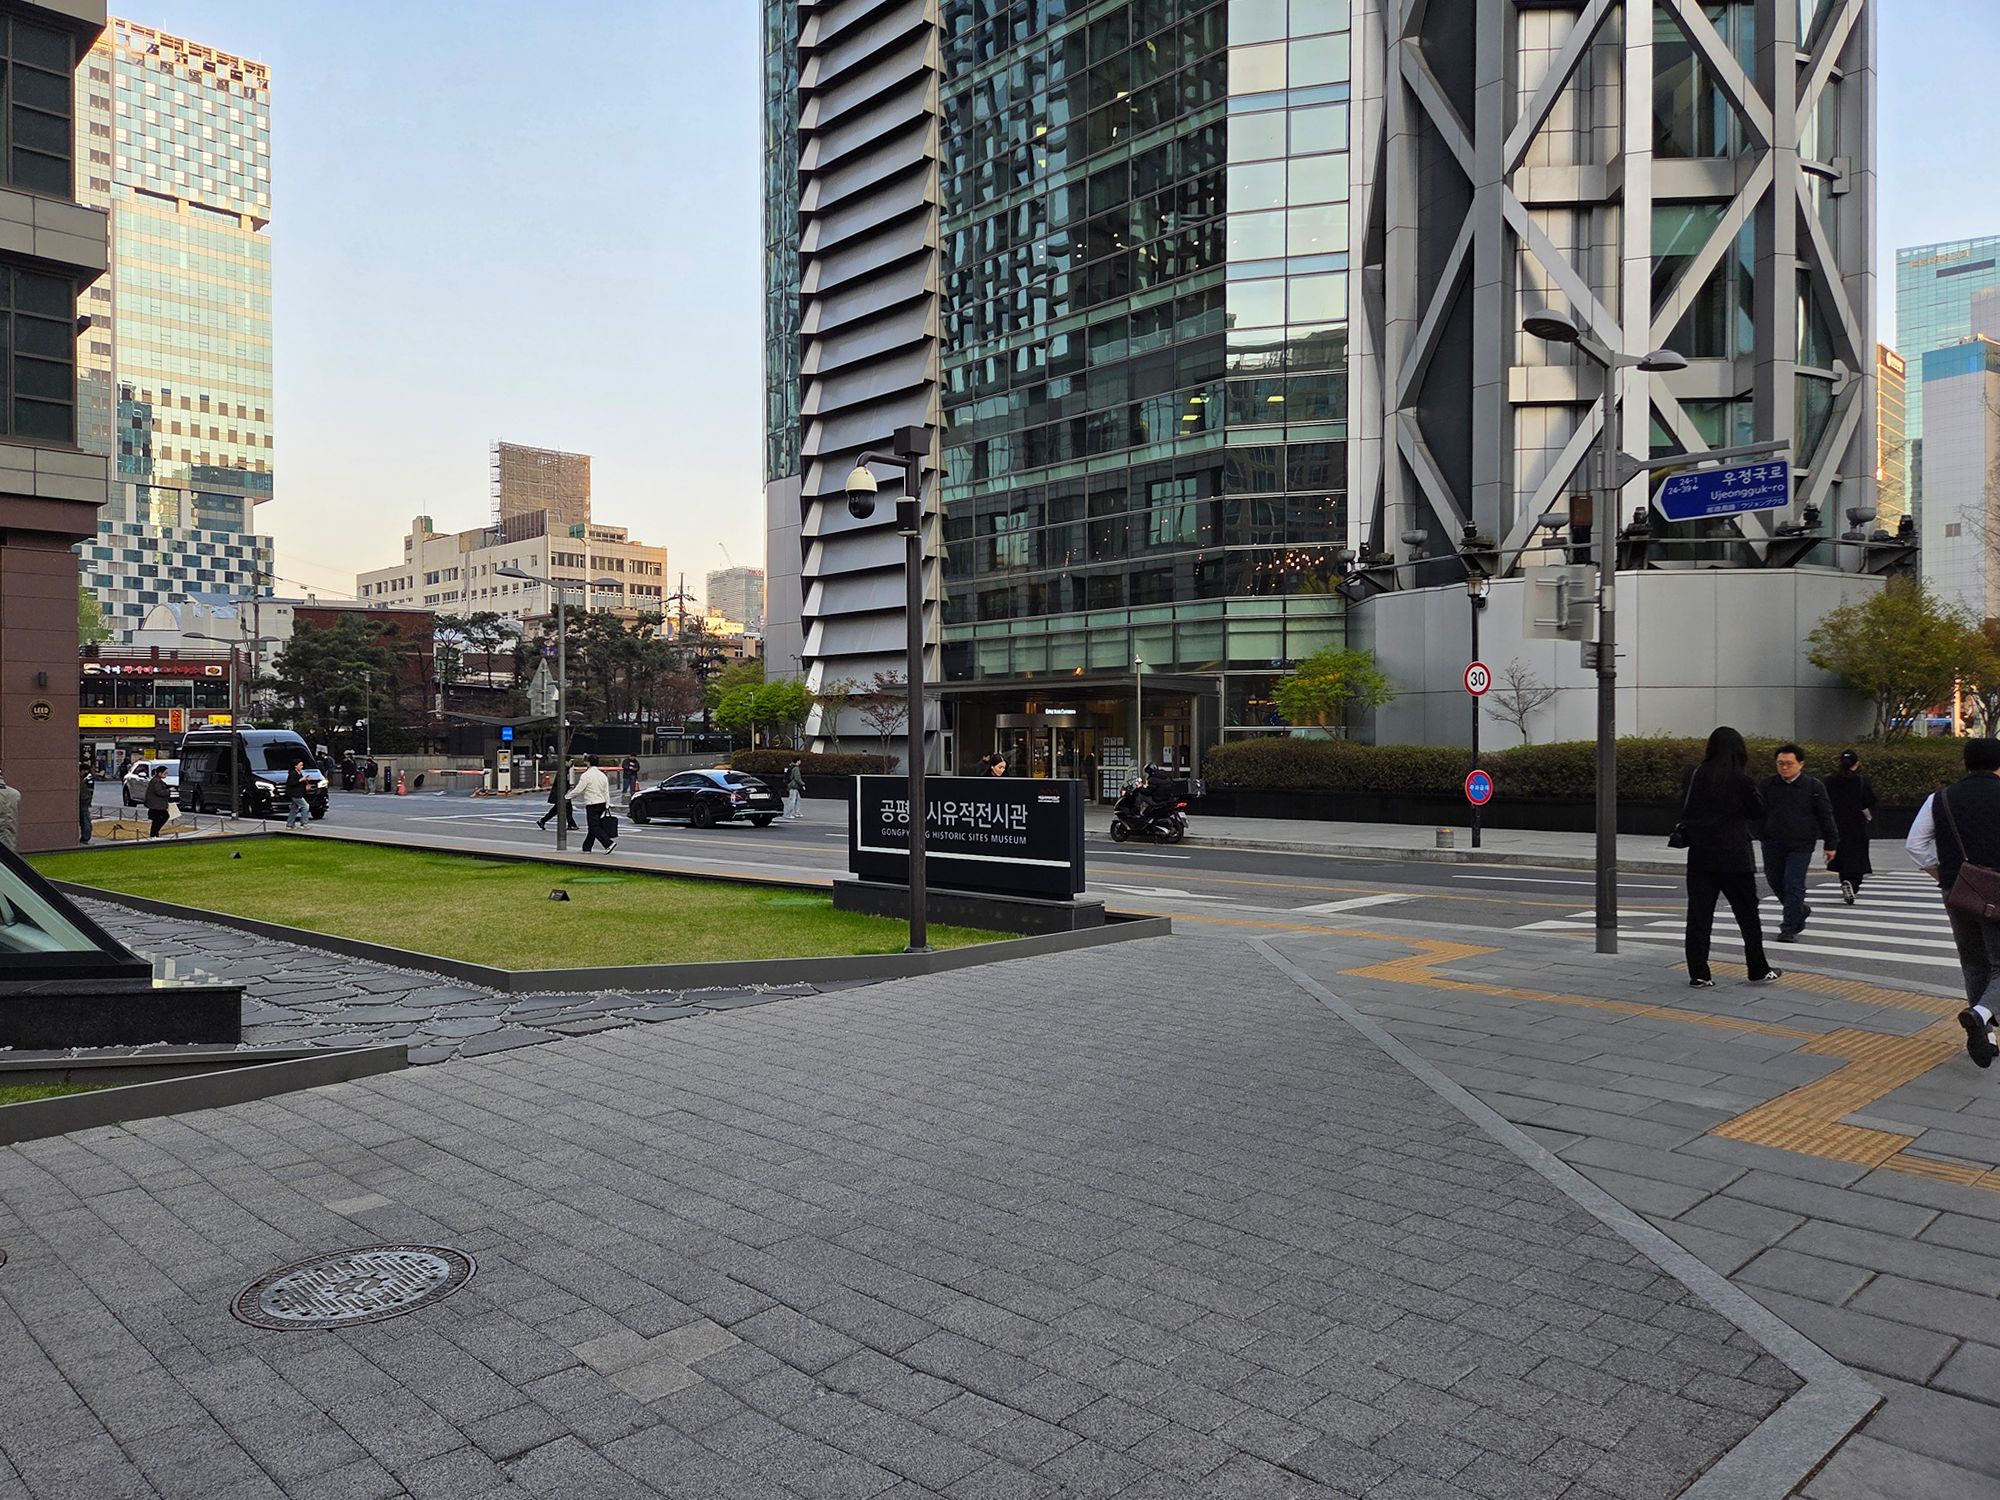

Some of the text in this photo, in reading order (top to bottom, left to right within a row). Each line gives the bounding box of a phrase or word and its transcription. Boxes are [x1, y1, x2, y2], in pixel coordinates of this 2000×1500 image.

[1679, 477, 1698, 487] 24-1
[1721, 465, 1784, 486] 우정국로
[1667, 485, 1692, 496] 24-39
[1710, 484, 1785, 502] Ujeongguk-ro
[1470, 671, 1485, 686] 30
[880, 799, 1028, 830] 공평시유적전시관
[881, 828, 1027, 845] GONGPYG HISTORIC SITES MUSEUM
